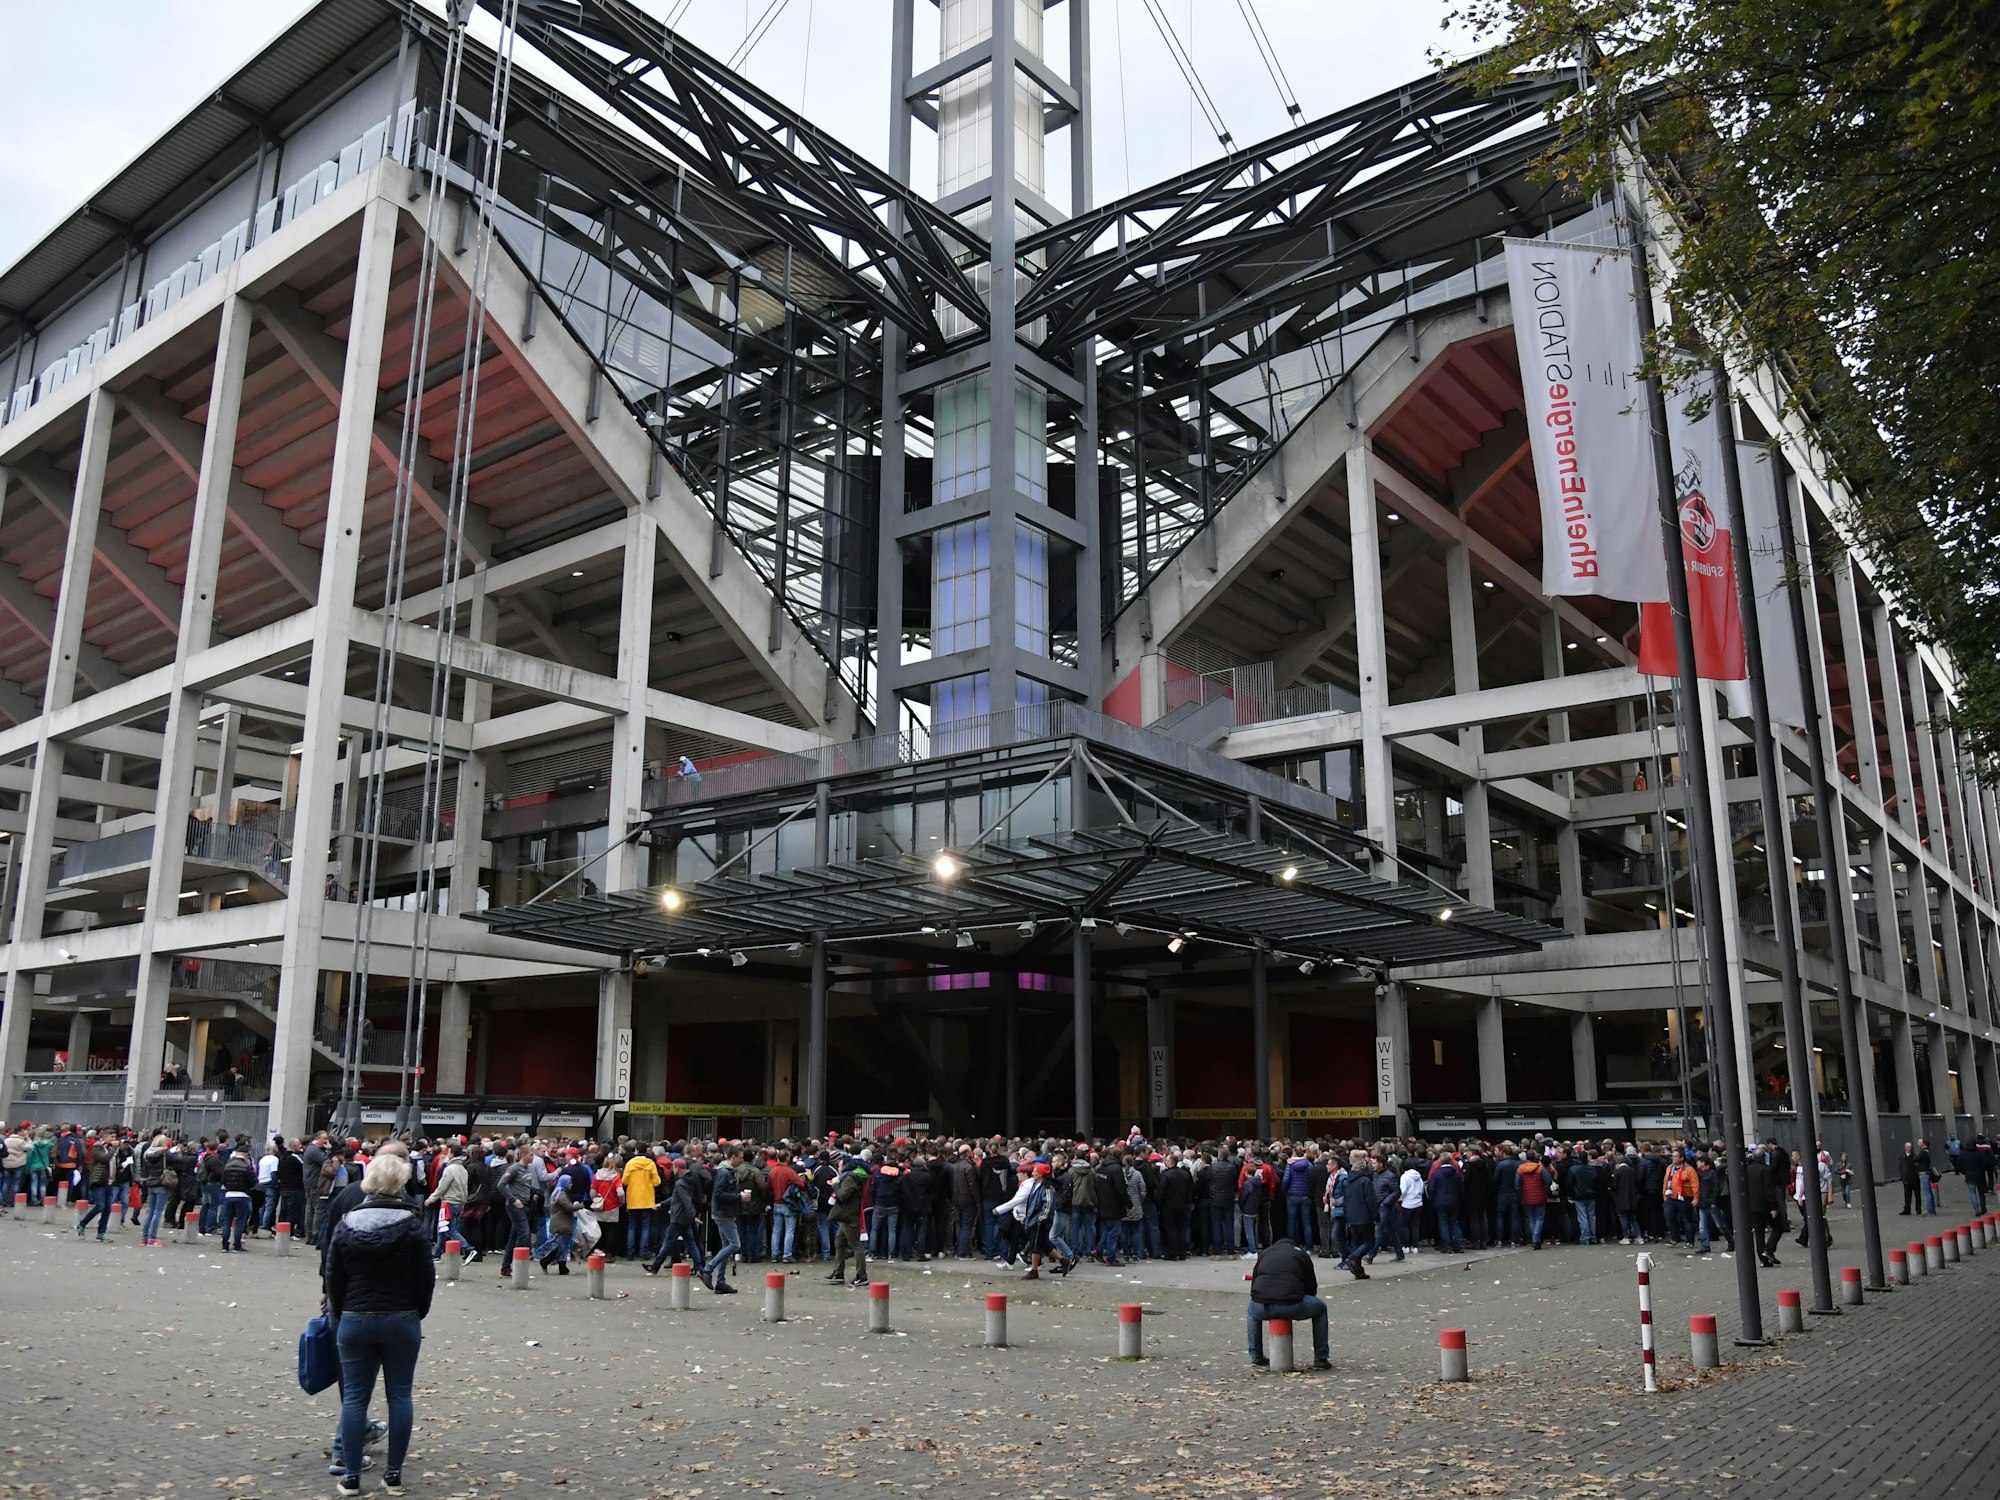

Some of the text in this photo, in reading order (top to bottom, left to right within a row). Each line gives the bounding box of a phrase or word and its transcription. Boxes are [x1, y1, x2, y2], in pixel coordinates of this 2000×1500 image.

[618, 1033, 629, 1098] NORD
[1152, 1050, 1164, 1106] WEST
[1377, 1041, 1391, 1103] WEST
[1341, 1109, 1363, 1117] Airport
